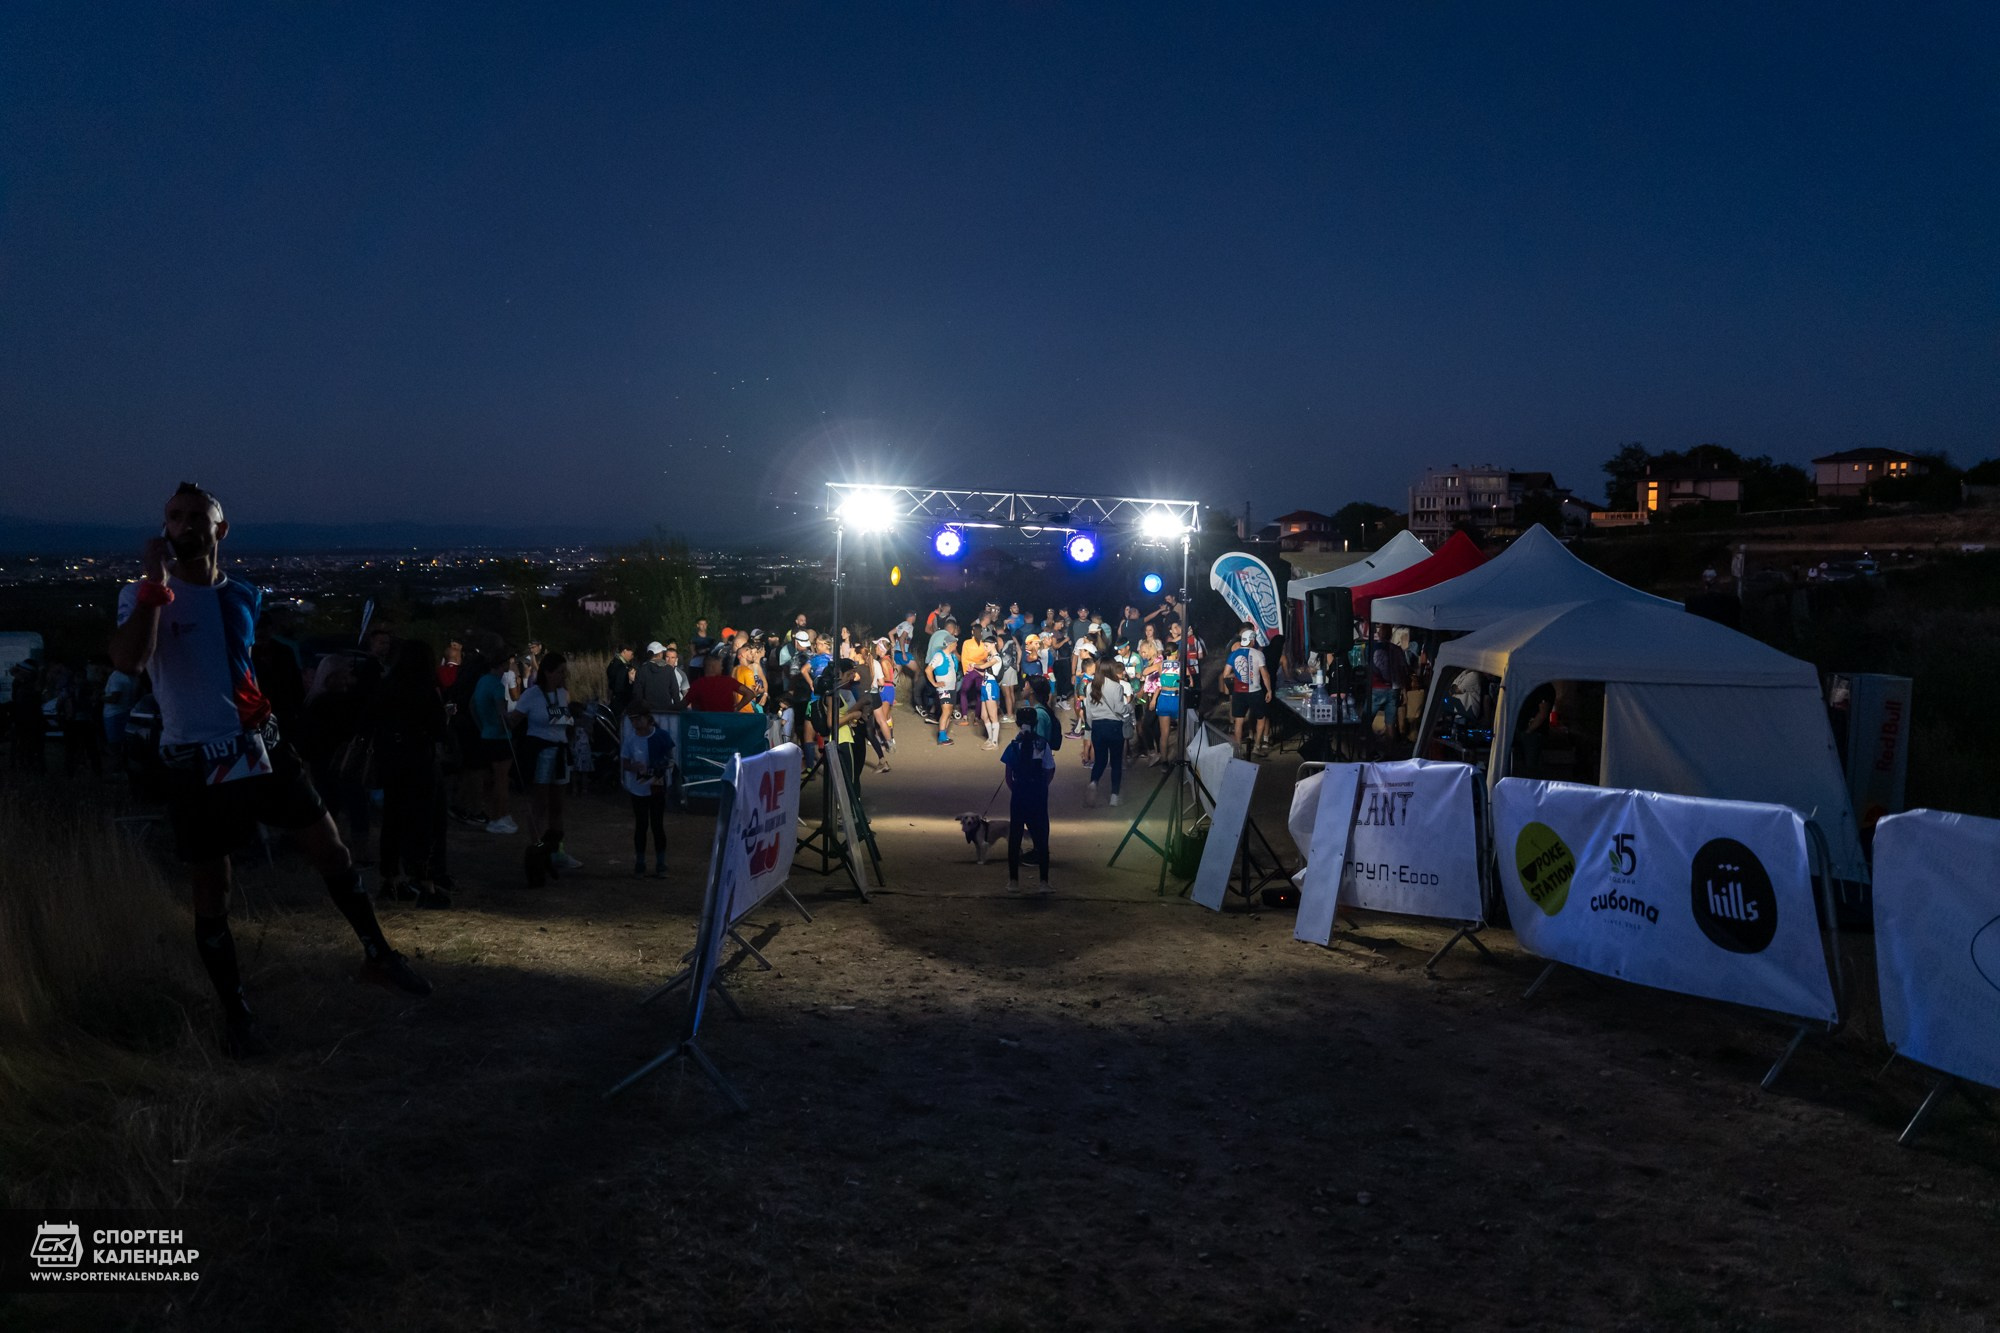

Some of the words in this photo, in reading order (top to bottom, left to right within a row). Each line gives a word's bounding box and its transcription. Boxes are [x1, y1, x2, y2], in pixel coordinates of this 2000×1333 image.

[1882, 701, 1904, 735] Bull
[1875, 737, 1896, 772] Red
[1355, 791, 1414, 826] ANT
[1534, 841, 1566, 872] POKE
[1611, 833, 1637, 876] 15
[1530, 861, 1574, 901] STATION
[1706, 878, 1760, 923] hills
